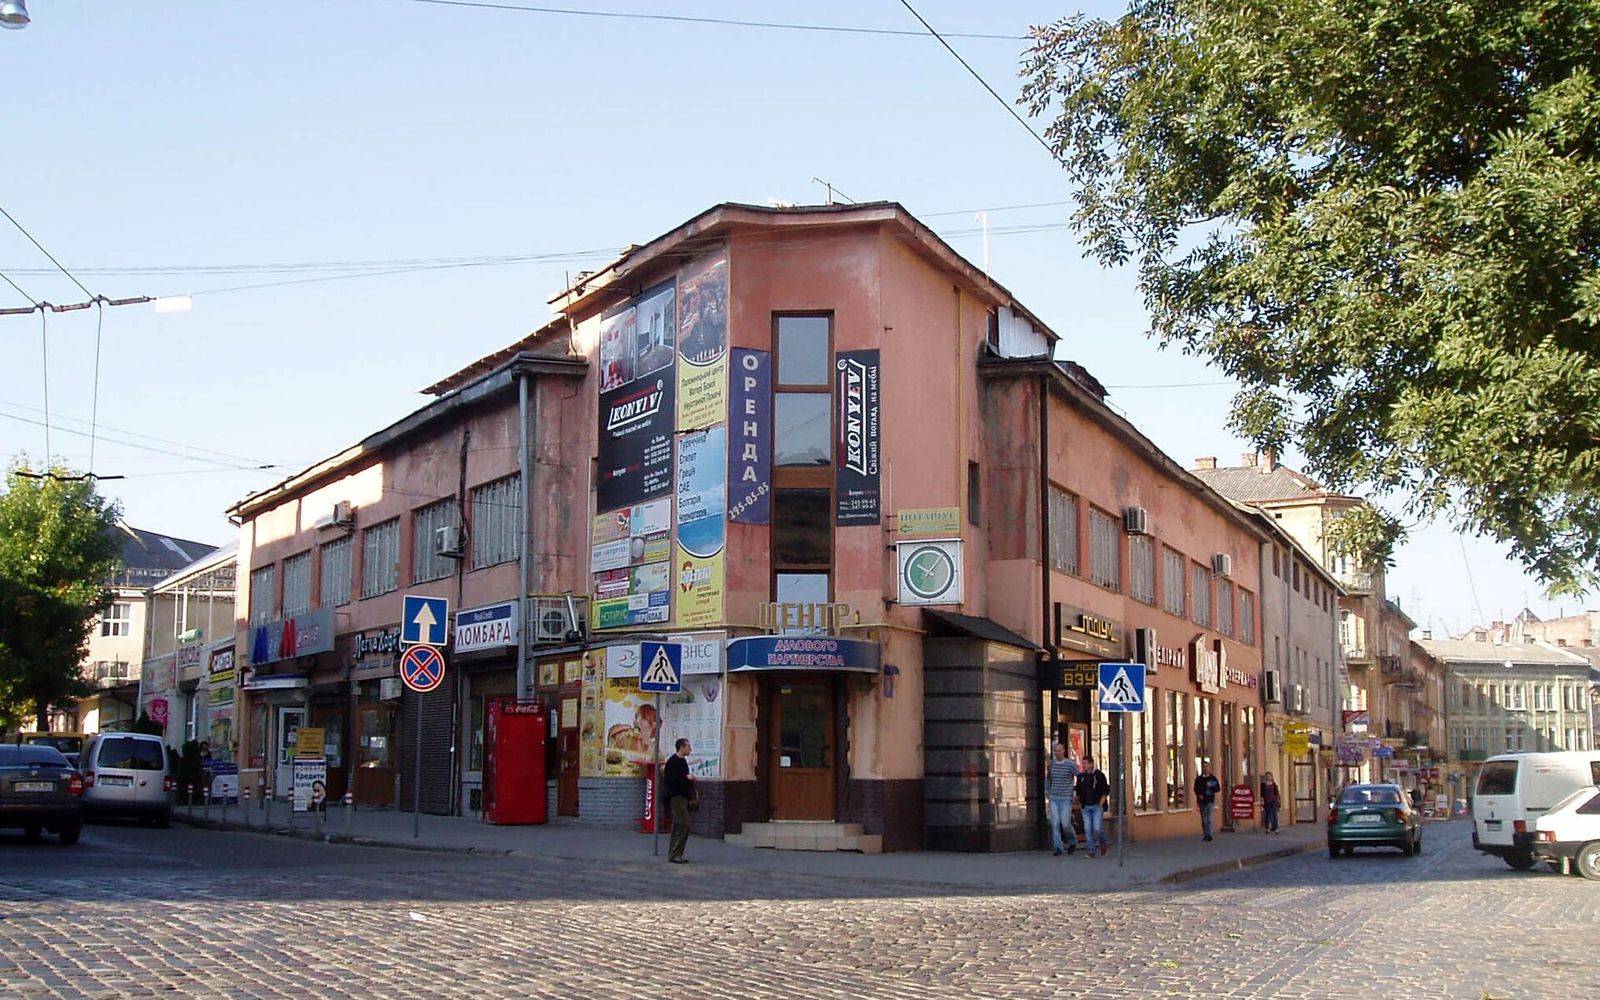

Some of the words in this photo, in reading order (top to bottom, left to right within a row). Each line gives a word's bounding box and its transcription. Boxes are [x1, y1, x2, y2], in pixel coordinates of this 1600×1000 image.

[870, 390, 876, 402] на
[742, 354, 759, 482] ОРЕНДА
[847, 368, 861, 465] KONYEV
[870, 406, 878, 437] погляд
[679, 481, 690, 493] ОАЕ
[728, 482, 769, 521] 295-05-05
[760, 602, 850, 634] ЦЕНТР
[457, 621, 511, 646] ЛОМБАРД
[775, 640, 838, 652] ДІЛОВОГО
[768, 653, 844, 666] ПАРТНЕРСТВА
[1064, 673, 1098, 685] ВЗУ
